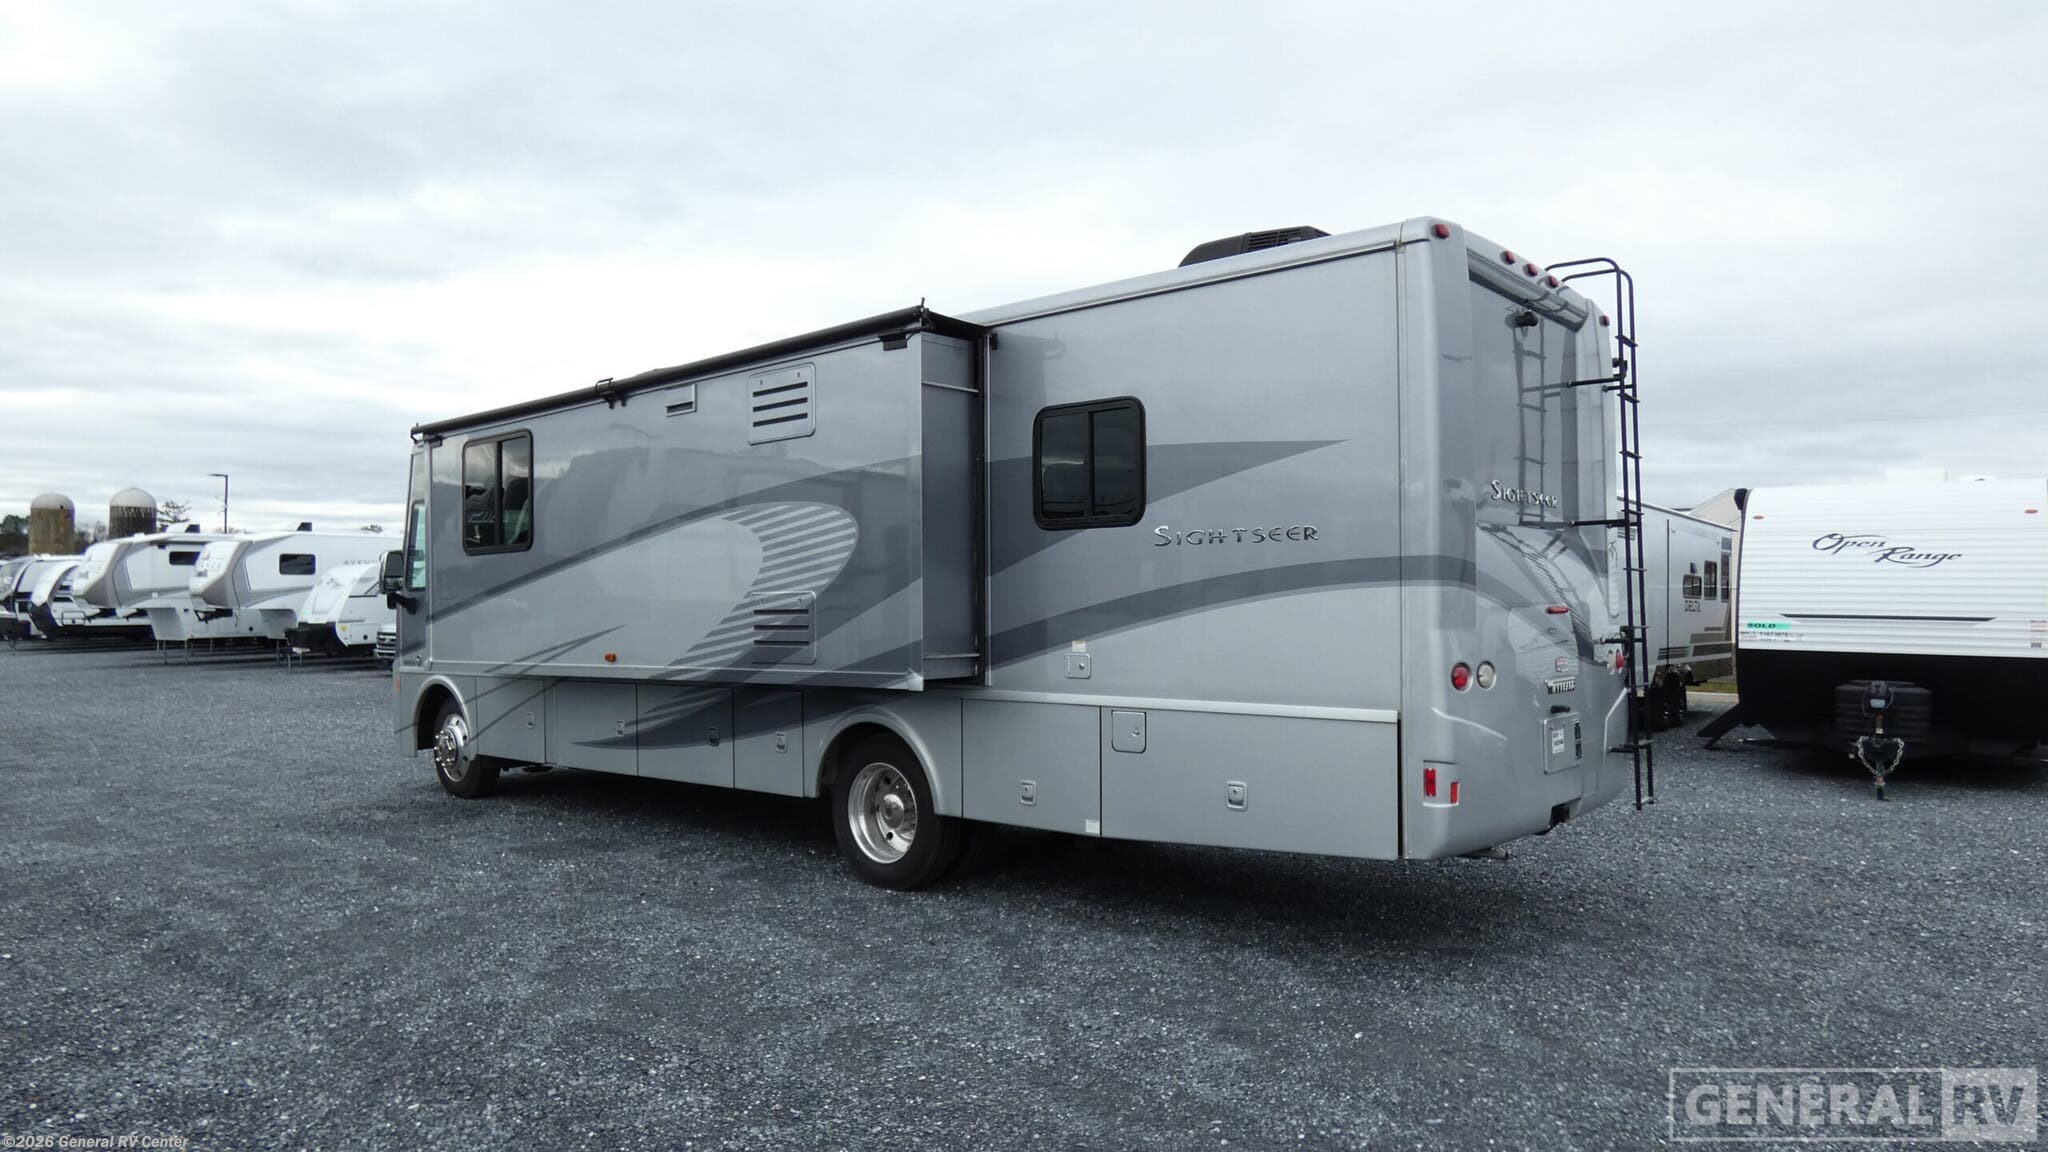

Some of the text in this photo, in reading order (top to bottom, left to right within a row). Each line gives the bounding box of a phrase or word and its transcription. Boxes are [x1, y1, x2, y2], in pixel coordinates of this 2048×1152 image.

[1153, 525, 1320, 547] SIGHTSEER
[1812, 533, 1888, 555] Open
[1866, 546, 1962, 568] Range
